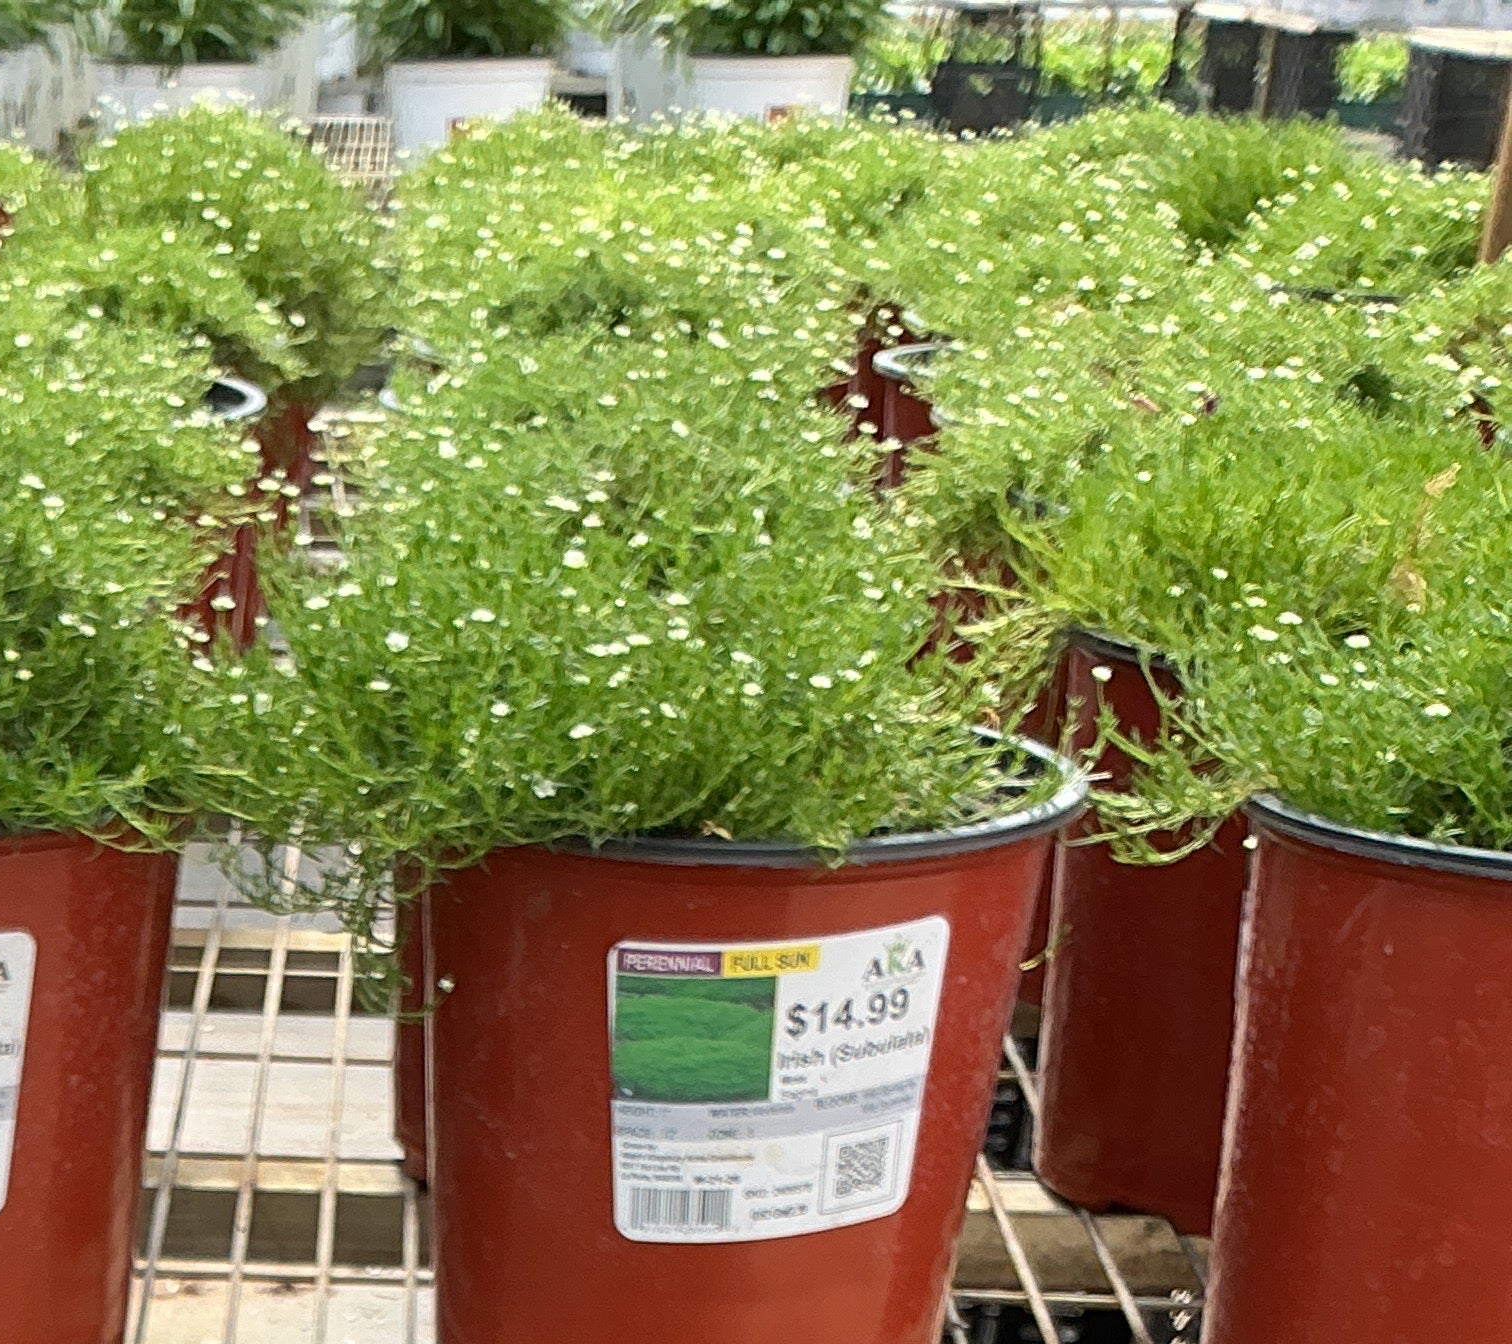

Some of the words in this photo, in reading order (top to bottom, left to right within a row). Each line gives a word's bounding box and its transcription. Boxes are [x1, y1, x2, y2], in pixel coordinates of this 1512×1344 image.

[623, 952, 714, 974] PERENNIAL
[730, 954, 773, 971] FULL
[775, 952, 810, 969] SUN
[863, 945, 926, 982] AKA
[785, 987, 910, 1038] $14.99
[777, 1049, 826, 1071] Irish
